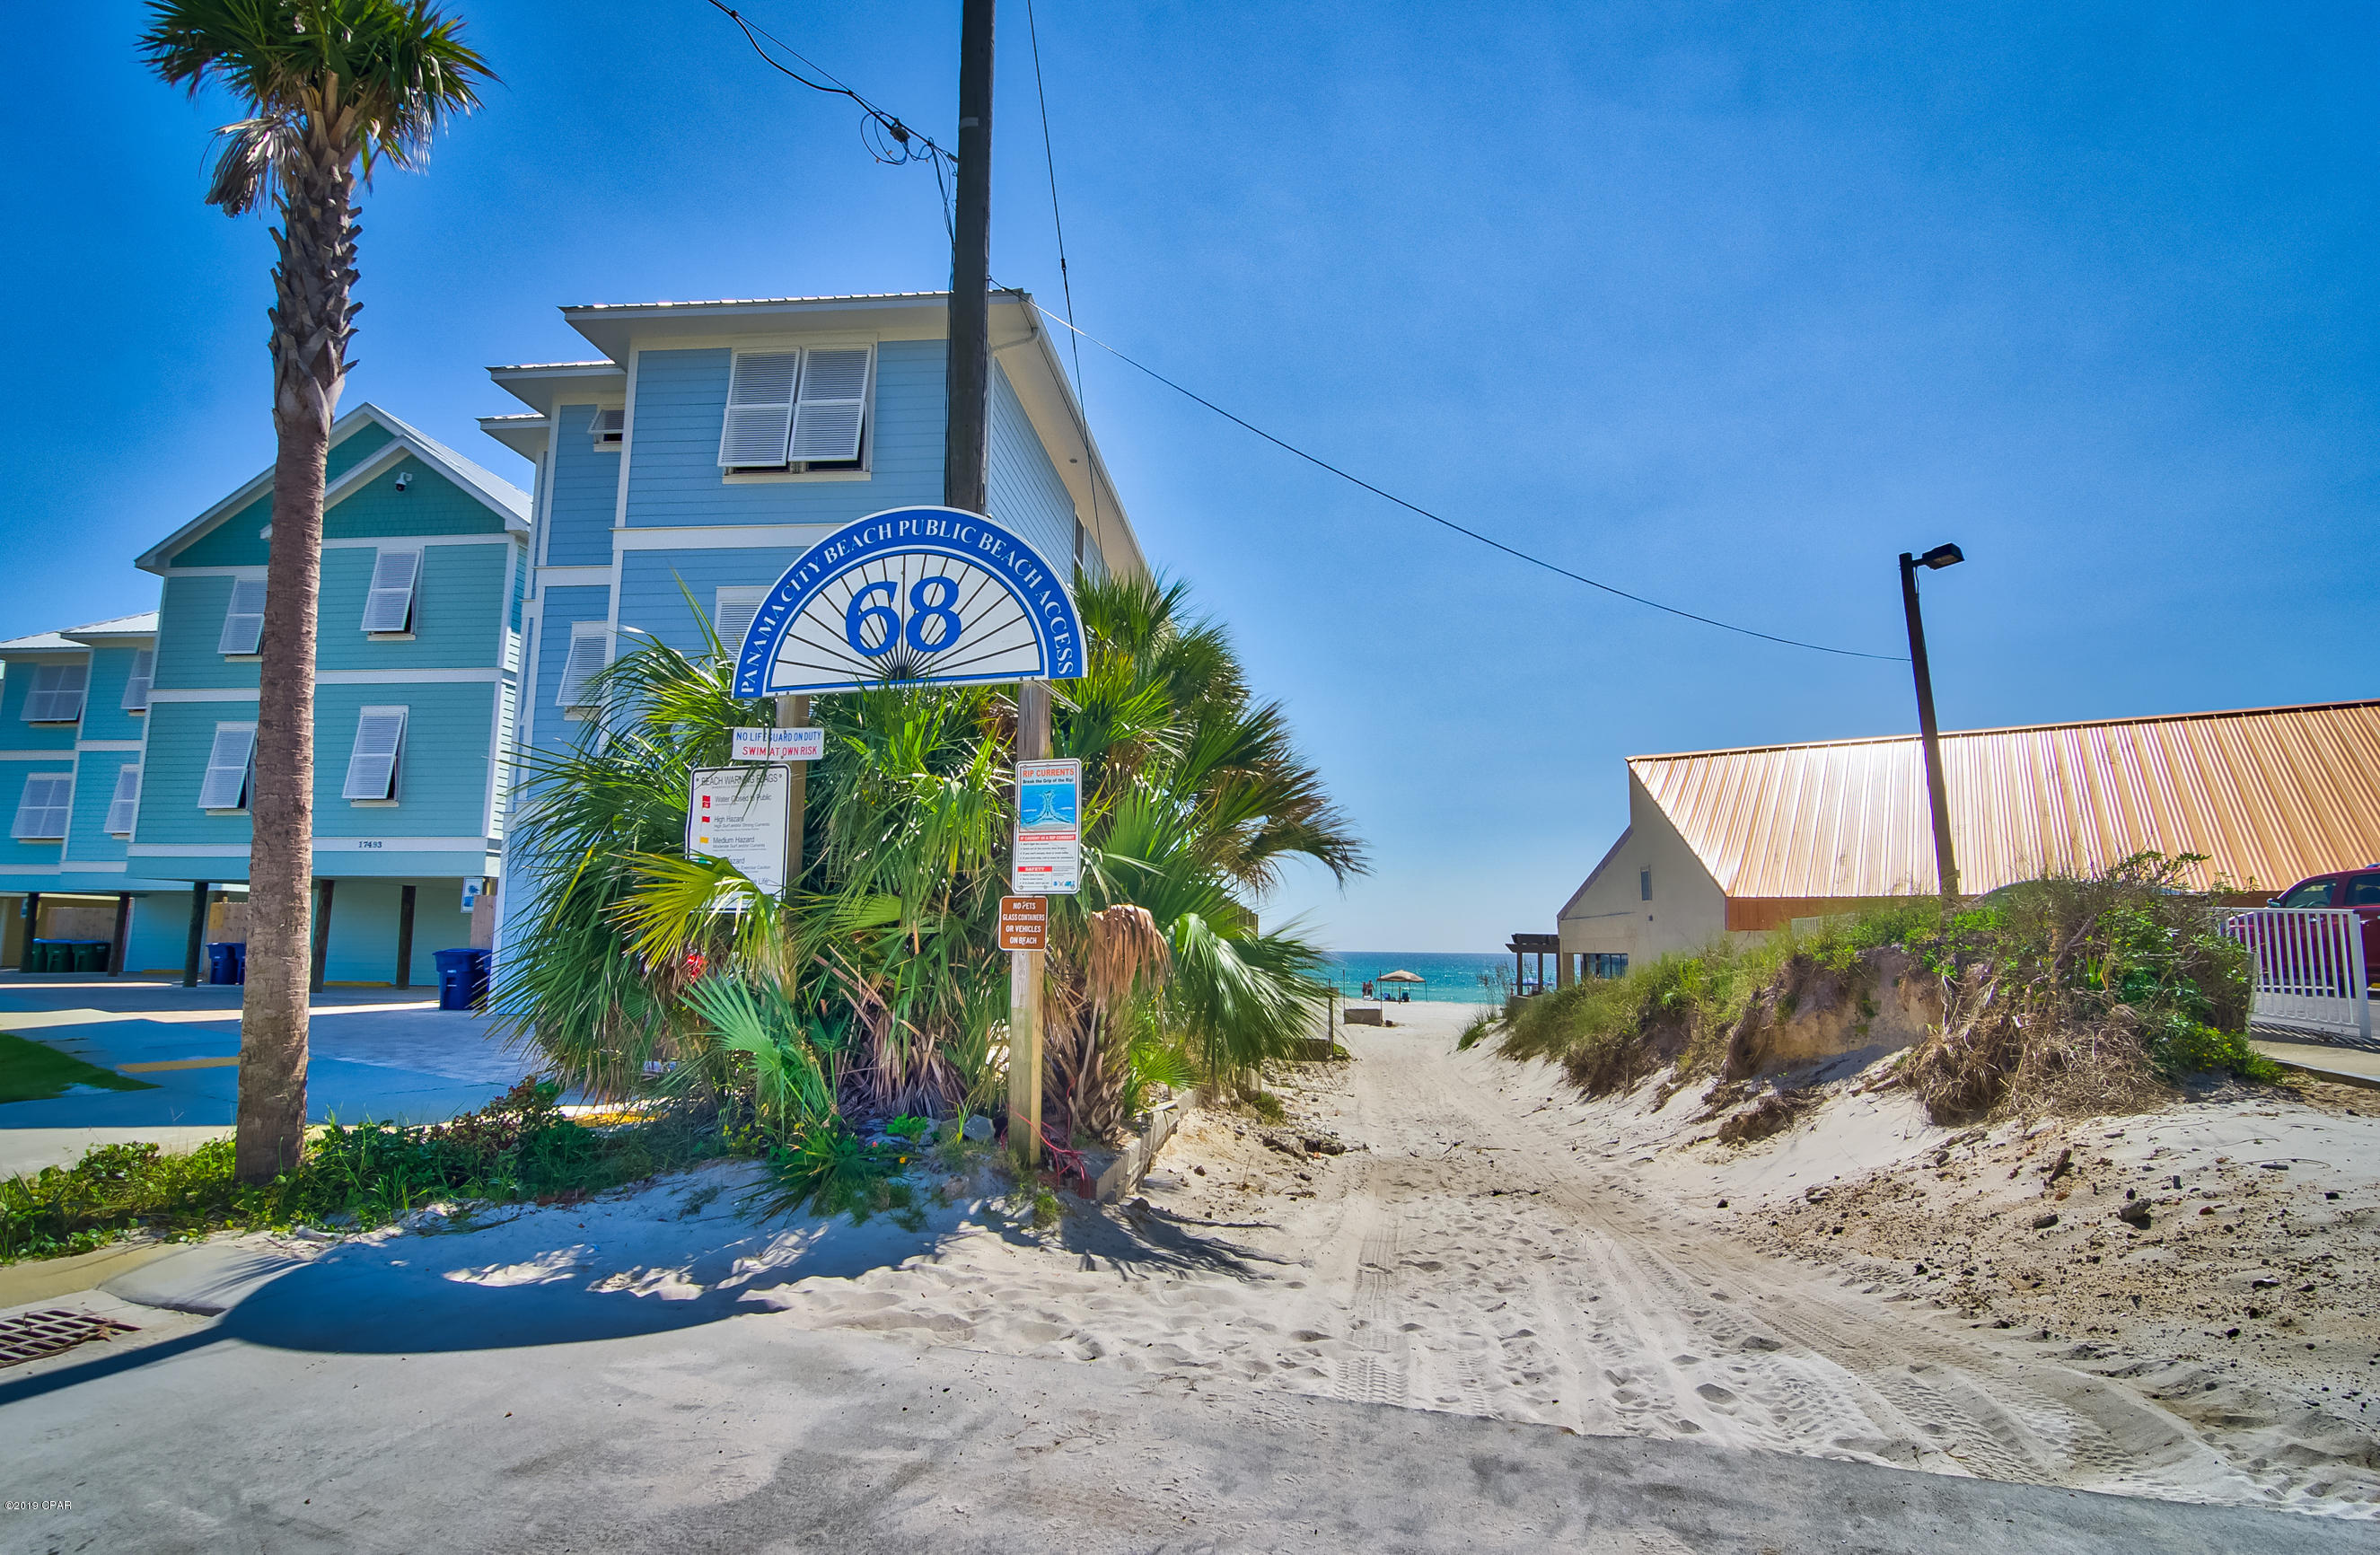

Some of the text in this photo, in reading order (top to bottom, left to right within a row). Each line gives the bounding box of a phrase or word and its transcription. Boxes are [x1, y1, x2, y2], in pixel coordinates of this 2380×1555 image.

[740, 518, 1075, 694] PANAMA CITY BEACH PUBLIC BEACH ACCESS
[846, 575, 962, 657] 68
[736, 732, 748, 741] NO
[794, 733, 803, 741] ON
[804, 732, 821, 741] DUTY
[742, 745, 818, 756] SWIM AT OWN RISK
[1023, 768, 1075, 778] RIP CURRENTS
[701, 773, 778, 786] BEACH WARNNG FAGS
[715, 816, 725, 824] High
[729, 857, 745, 865] azard
[1013, 901, 1036, 909] NO PETS
[1006, 925, 1041, 933] OR VEHICLES
[1009, 936, 1038, 944] ON BEACH
